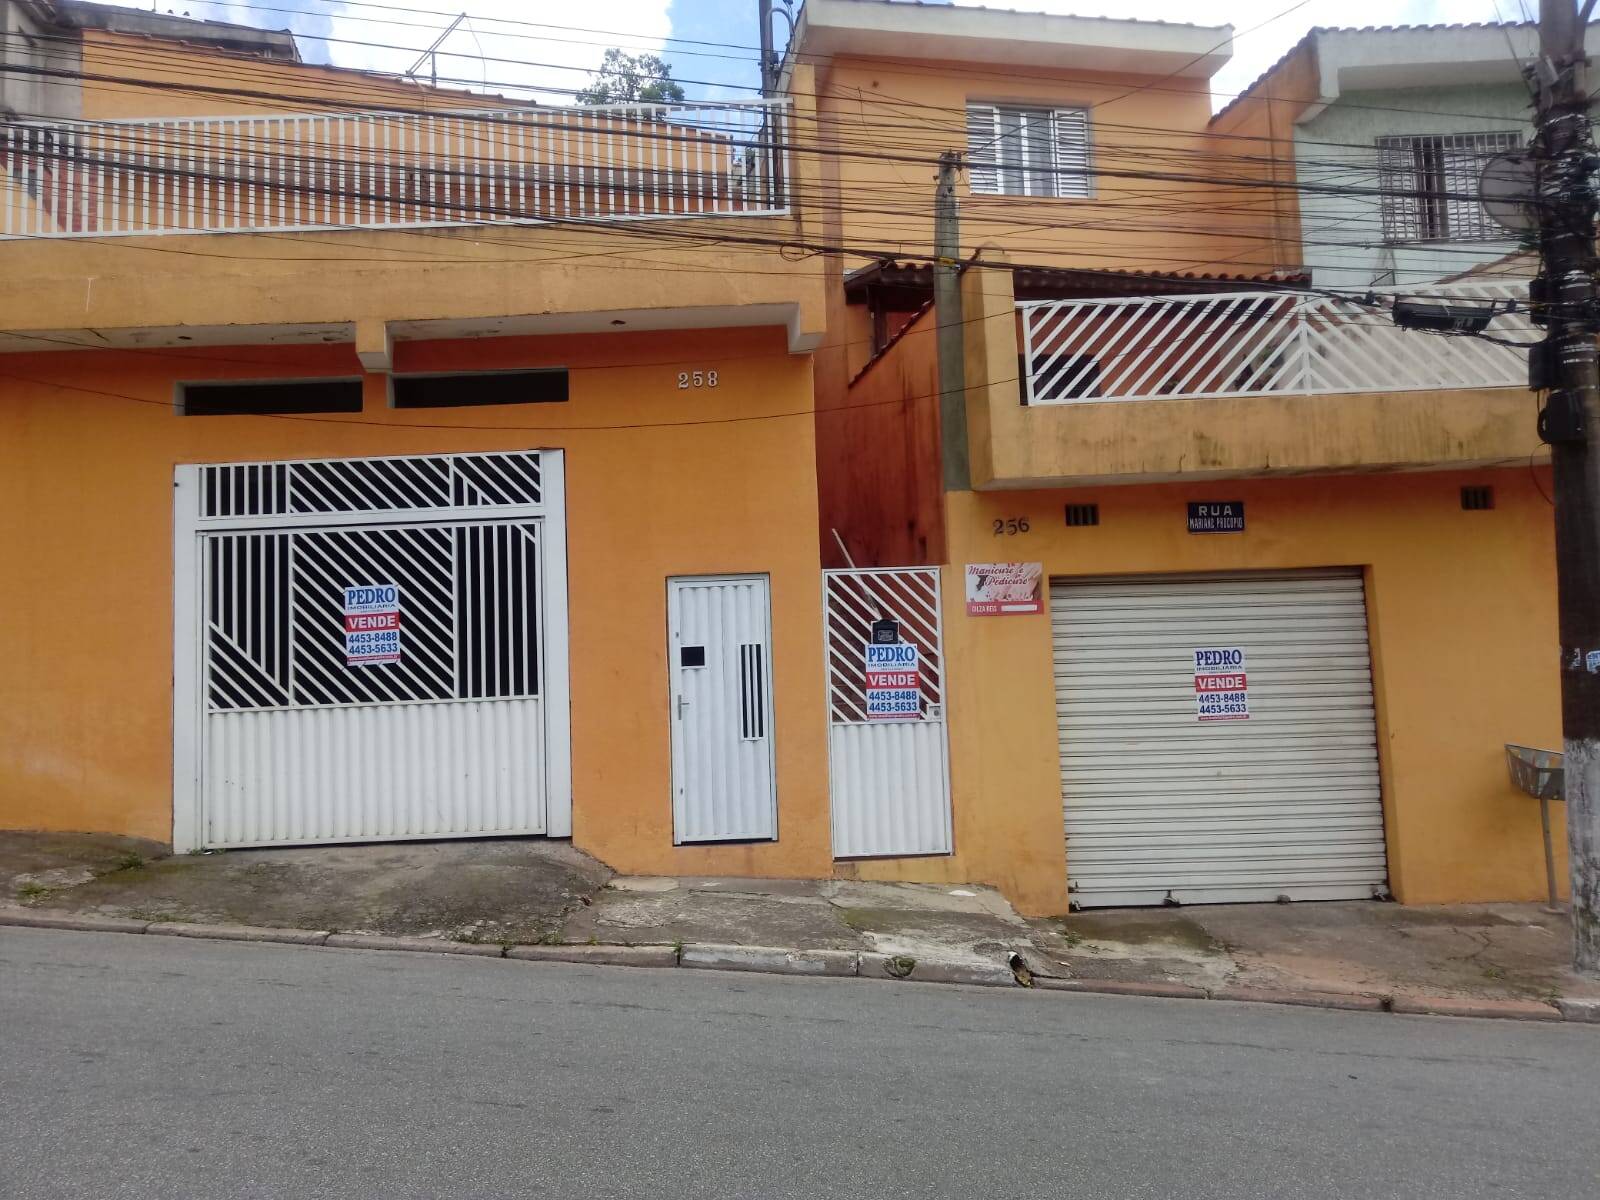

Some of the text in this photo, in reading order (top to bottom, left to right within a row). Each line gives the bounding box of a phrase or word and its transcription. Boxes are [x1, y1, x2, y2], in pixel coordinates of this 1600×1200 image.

[678, 370, 718, 389] 258
[1198, 504, 1233, 517] RUA
[992, 518, 1030, 536] 256
[968, 565, 1013, 575] Manicure
[348, 587, 396, 606] PEDRO
[349, 615, 396, 629] VENDE
[348, 631, 398, 644] 4453-8488
[348, 642, 398, 655] 4453-5633
[867, 646, 916, 663] PEDRO
[1195, 649, 1243, 667] PEDRO
[868, 674, 916, 687] VENDE
[1197, 676, 1244, 690] VENDE
[868, 690, 917, 702] 4453-8488
[1198, 692, 1246, 704] 4453-8488
[868, 701, 917, 713] 4453-5633
[1199, 703, 1247, 715] 4453-5633
